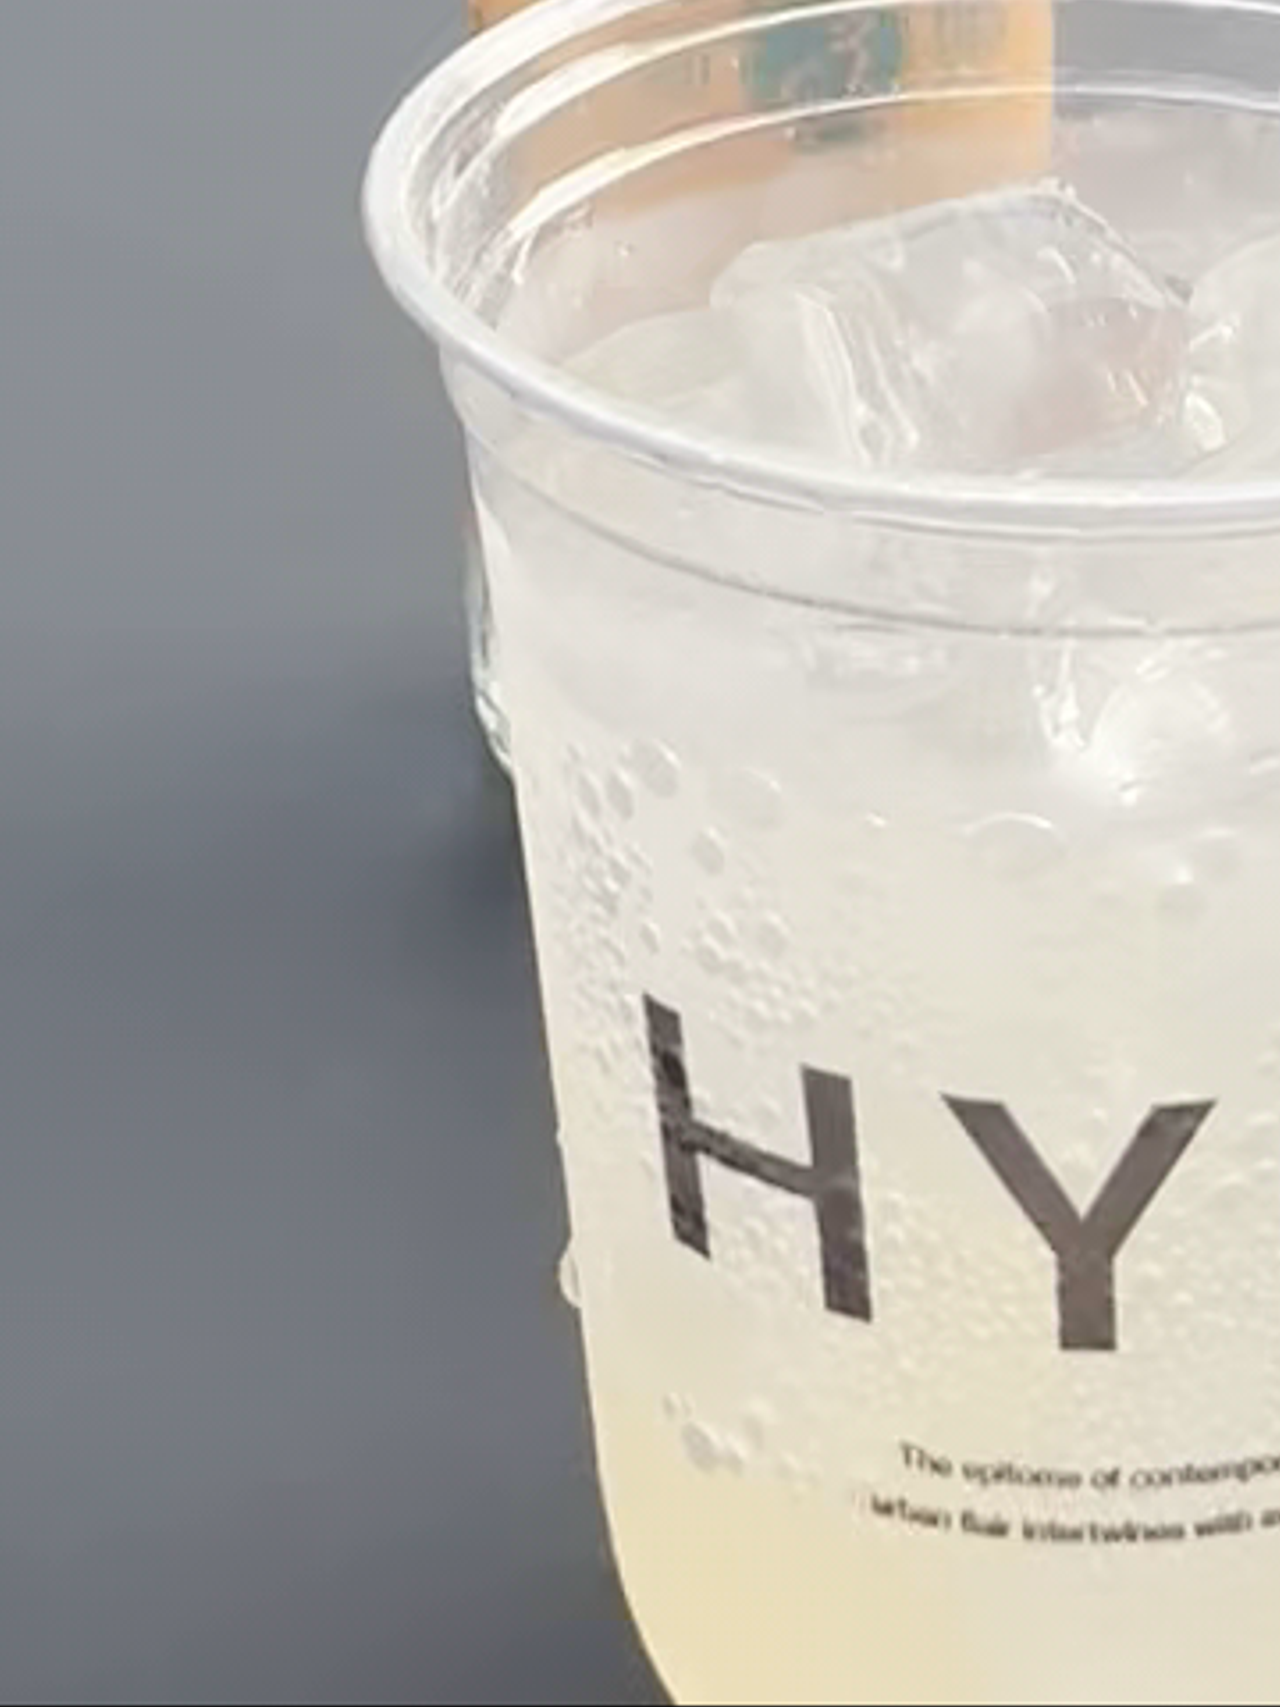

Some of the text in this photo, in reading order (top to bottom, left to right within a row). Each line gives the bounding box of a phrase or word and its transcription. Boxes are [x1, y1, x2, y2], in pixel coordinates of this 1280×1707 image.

[900, 1442, 952, 1477] The
[1090, 1468, 1119, 1488] of
[1194, 1510, 1253, 1538] with
